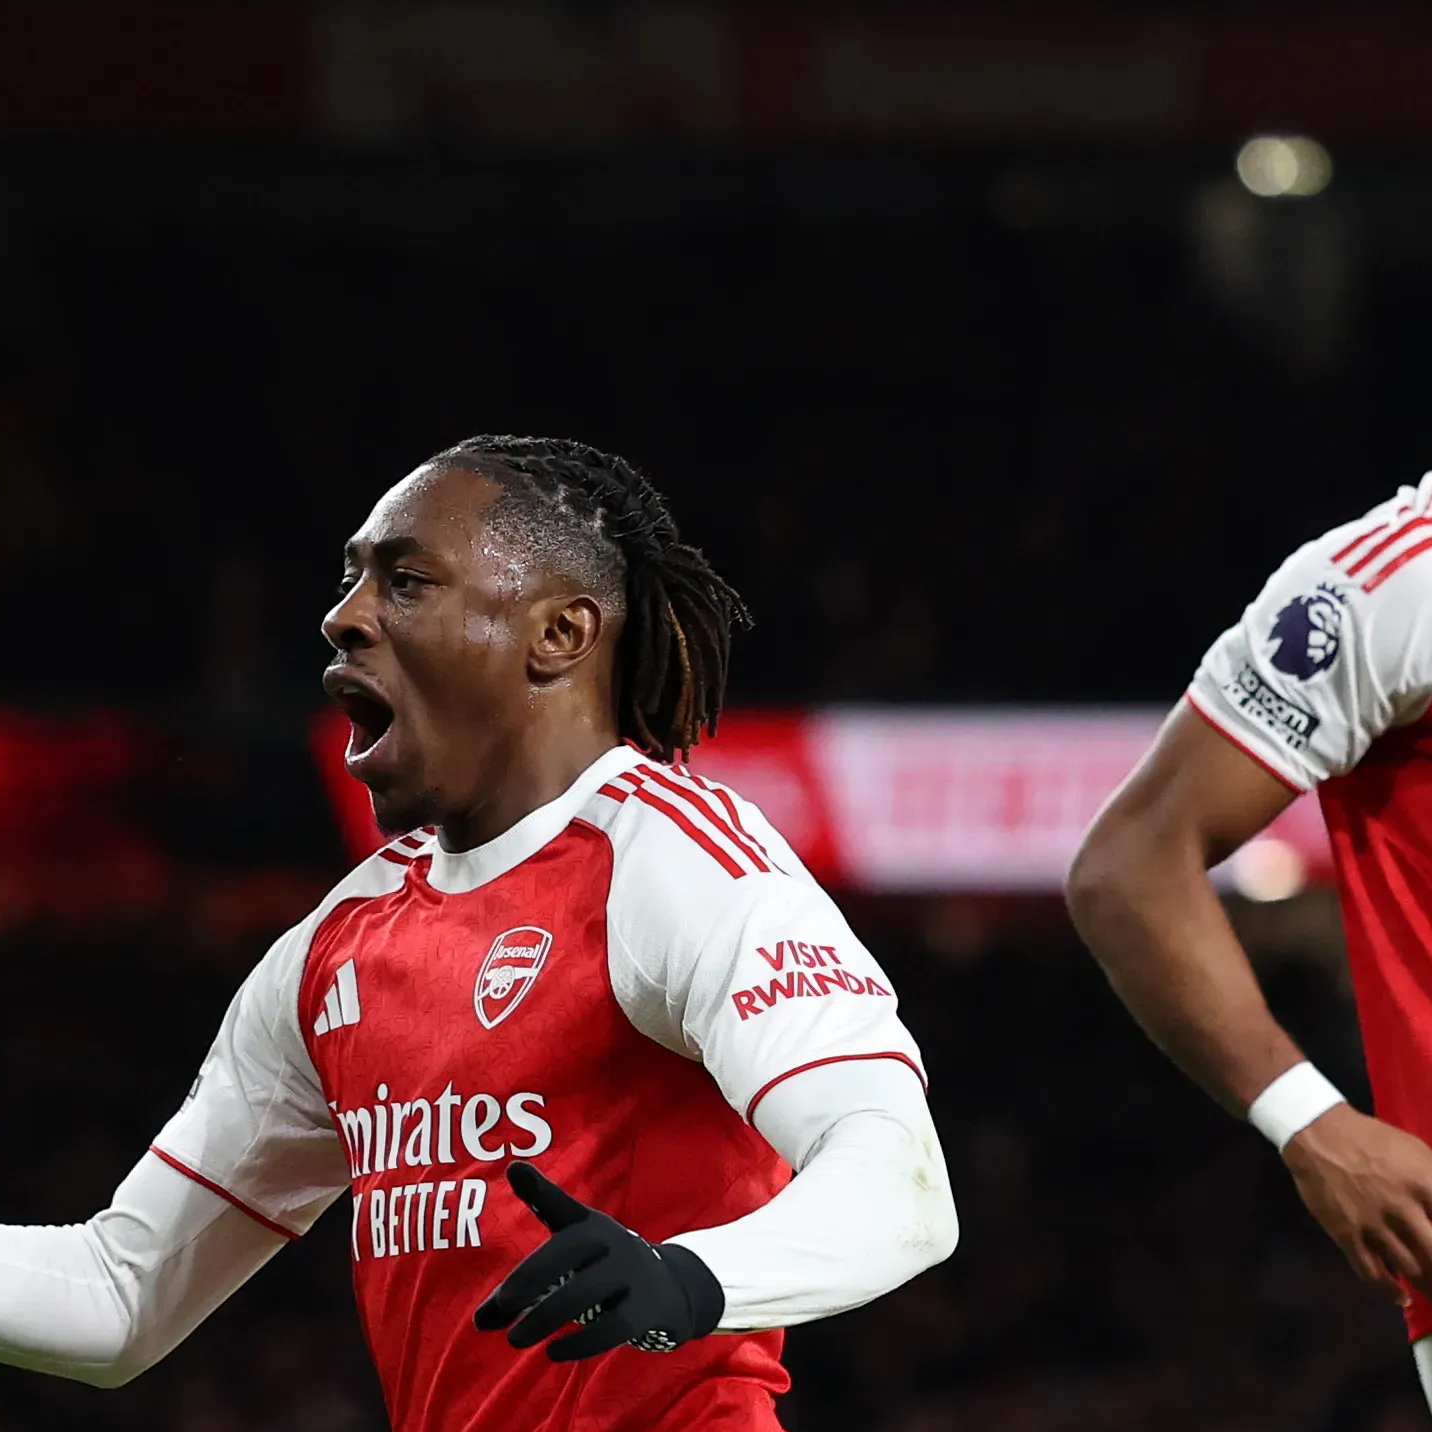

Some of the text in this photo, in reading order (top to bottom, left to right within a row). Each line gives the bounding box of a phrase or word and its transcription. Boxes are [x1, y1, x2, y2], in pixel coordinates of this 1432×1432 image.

[755, 940, 842, 971] VISIT
[731, 969, 892, 1021] RWANDA
[328, 1080, 552, 1179] mirates
[370, 1179, 487, 1258] BETTER
